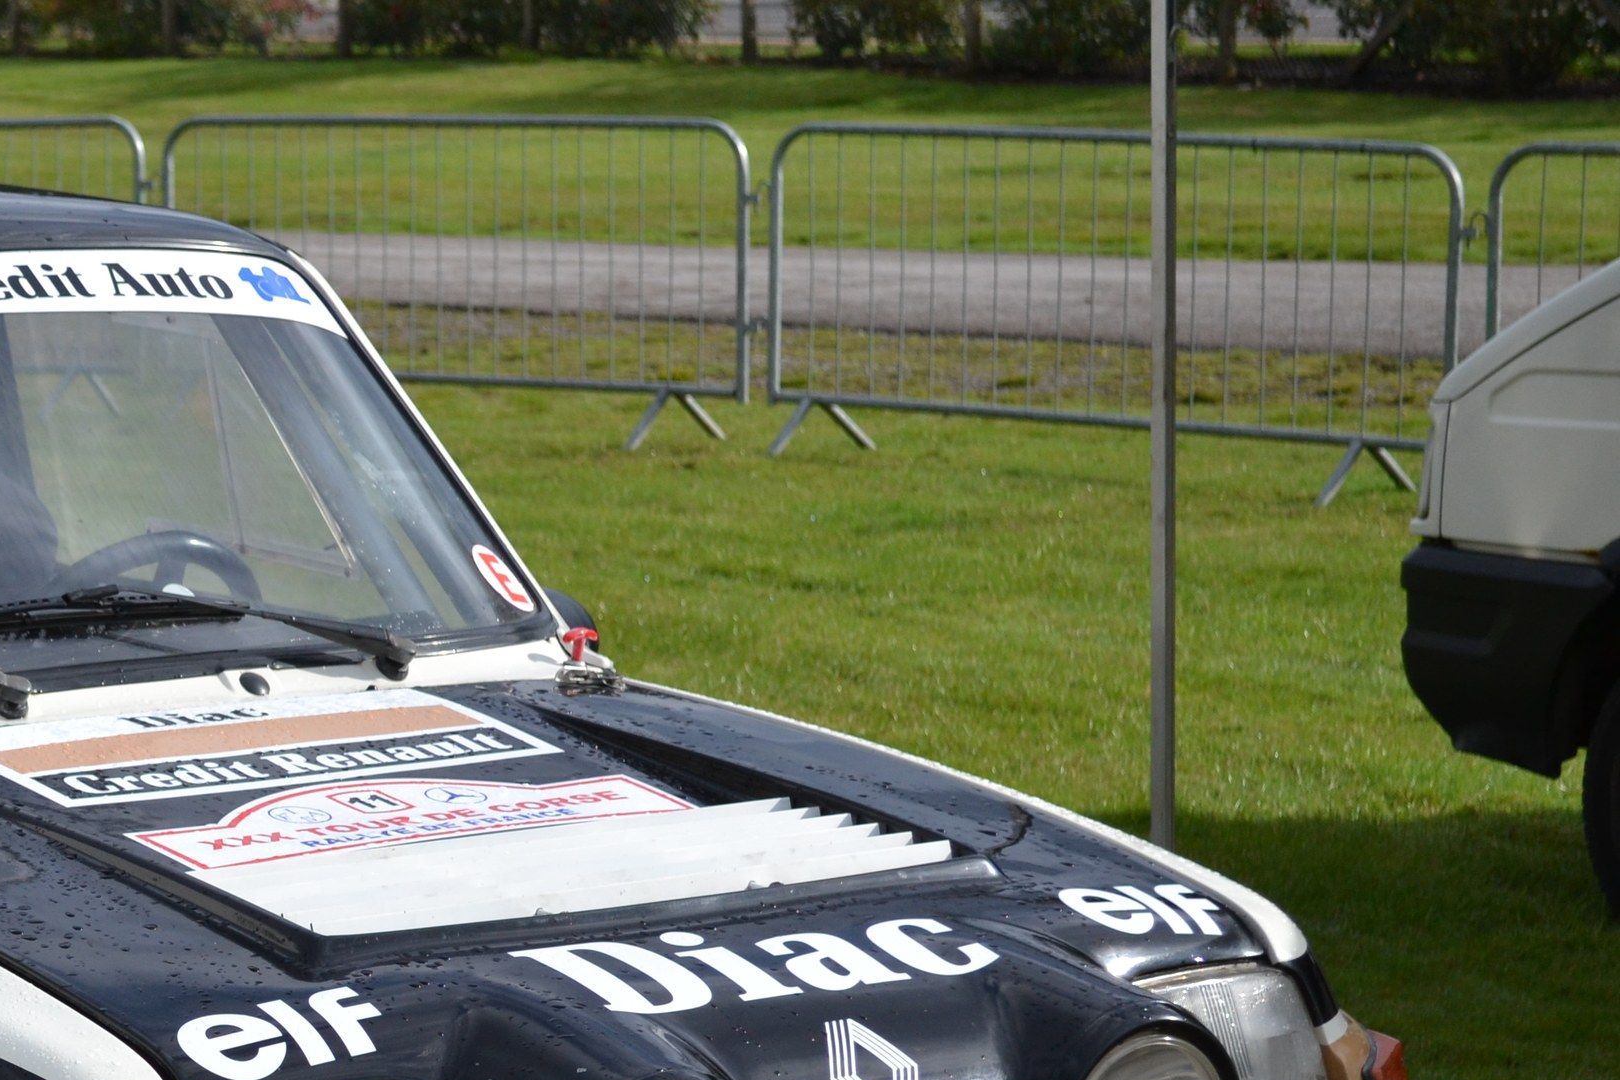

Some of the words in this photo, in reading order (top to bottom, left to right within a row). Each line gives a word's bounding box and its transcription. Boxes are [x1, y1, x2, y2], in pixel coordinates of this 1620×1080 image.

[101, 262, 233, 299] Auto
[264, 729, 514, 775] Renault
[200, 831, 297, 850] XXX
[295, 815, 420, 836] TOUR
[421, 808, 485, 822] DE
[488, 789, 628, 813] CORSE
[347, 794, 398, 809] 11
[1058, 884, 1224, 936] elf
[507, 917, 1001, 1014] Diac
